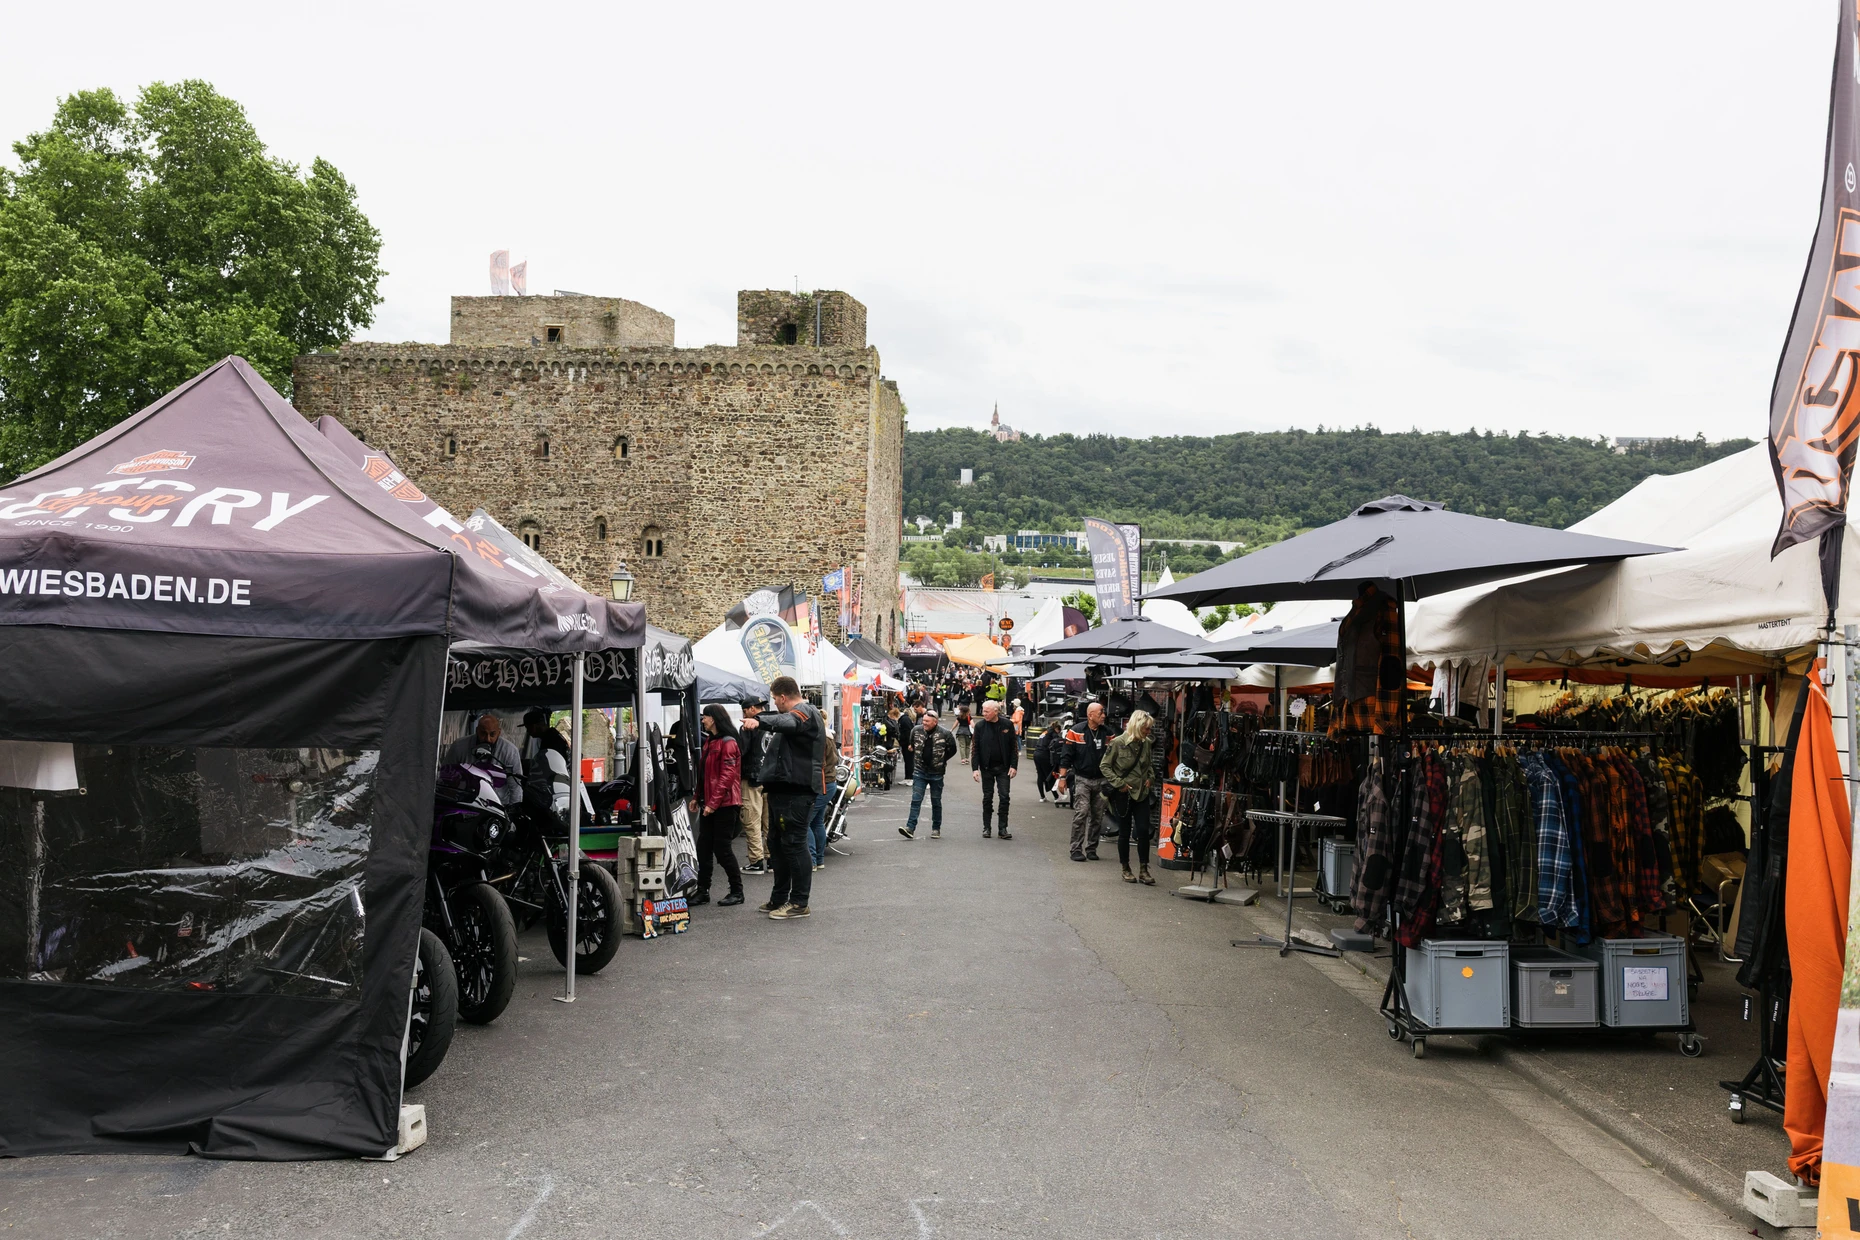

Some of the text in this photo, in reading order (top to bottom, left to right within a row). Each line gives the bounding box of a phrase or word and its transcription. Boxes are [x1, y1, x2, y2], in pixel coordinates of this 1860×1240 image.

[0, 476, 331, 532] CTORY
[15, 519, 134, 533] SINCE 1990
[1758, 619, 1791, 629] MASTERTENT
[447, 650, 631, 694] BEHAVIOR
[653, 898, 687, 912] HIPSTERS
